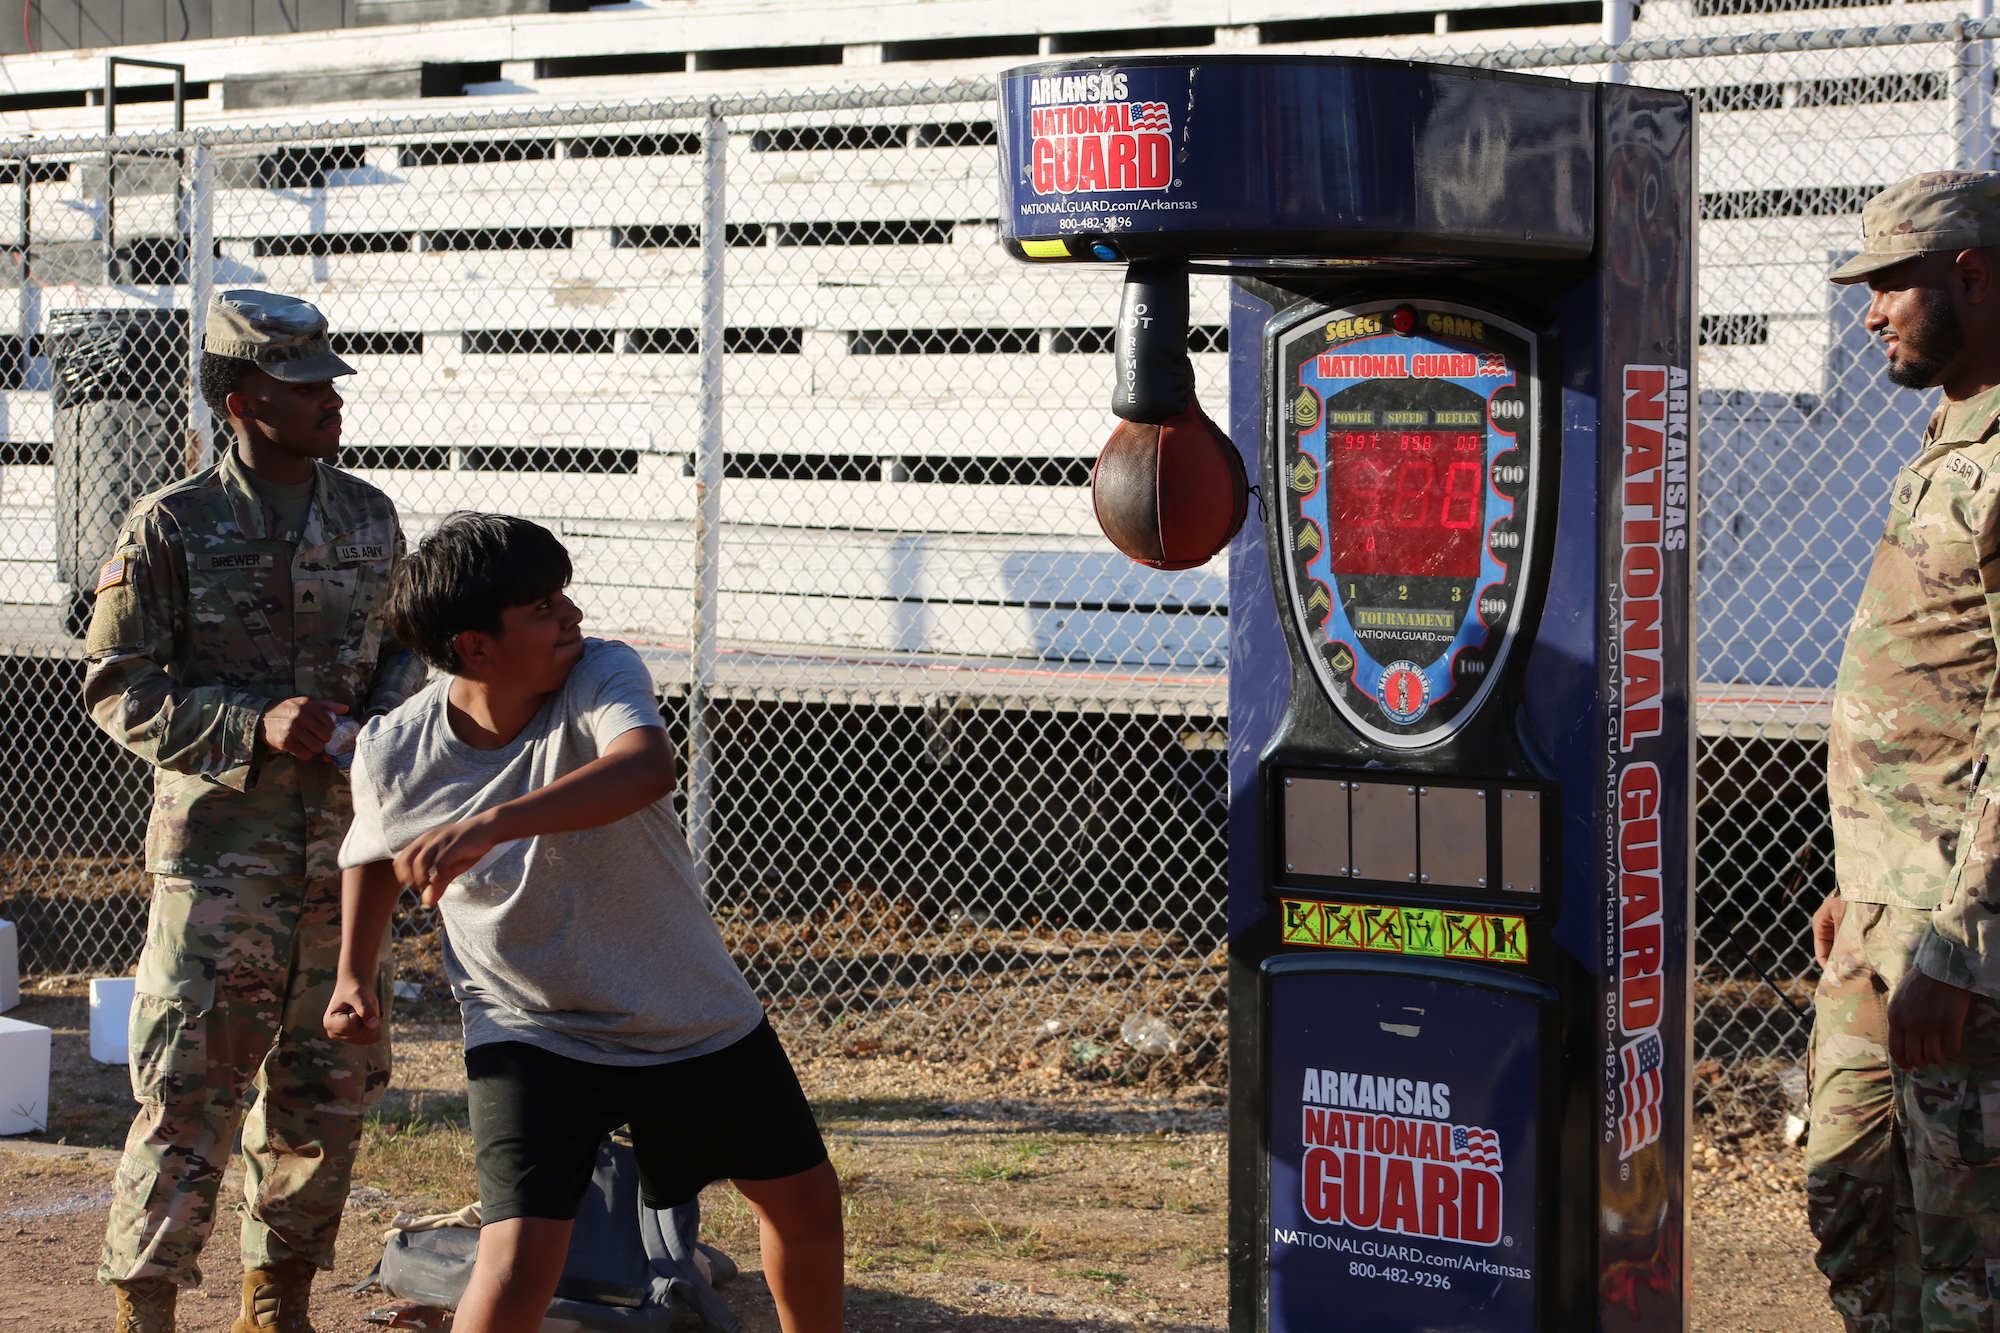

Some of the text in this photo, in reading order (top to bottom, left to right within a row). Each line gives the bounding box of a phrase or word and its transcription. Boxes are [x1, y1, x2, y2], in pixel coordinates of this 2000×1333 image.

[1031, 73, 1128, 105] ARKANSAS
[1031, 104, 1133, 138] NATIONAL
[1032, 132, 1172, 193] GUARD
[1020, 199, 1198, 216] NATIONALGUARD.com/Arkansas
[1124, 303, 1147, 316] DO
[1119, 317, 1153, 329] NOT
[1325, 313, 1484, 342] SELECT GAME
[1125, 337, 1137, 404] REMOVE
[1318, 354, 1476, 378] NATIONAL GUARD
[1333, 413, 1479, 424] POWER SPEED REFLEX
[1490, 399, 1525, 420] 900
[1345, 435, 1376, 450] 997
[1400, 435, 1432, 450] 898
[1665, 366, 1688, 552] ARKANSAS
[1493, 465, 1525, 484] 700
[1490, 531, 1519, 549] 500
[211, 554, 260, 568] BREWER
[341, 545, 383, 559] U.S. ARMY
[1349, 583, 1461, 602] 1 2 3
[1479, 598, 1507, 614] 300
[1358, 611, 1453, 628] TOURNAMENT
[1353, 629, 1455, 642] NATIONALGUARD.com
[1378, 662, 1430, 693] NATIONAL GUARD
[1460, 660, 1485, 674] 100
[1618, 365, 1667, 1036] NATIONAL GUARD
[1605, 583, 1618, 1142] NATIONALGUARD.com/Arkansas 800-482-9296
[1302, 1067, 1450, 1119] ARKANSAS
[1303, 1107, 1455, 1163] NATIONAL
[1303, 1146, 1502, 1246] GUARD
[1274, 1228, 1531, 1280] NATIONALGUARD.com/Arkansas
[1349, 1261, 1451, 1290] 800-482-9296
